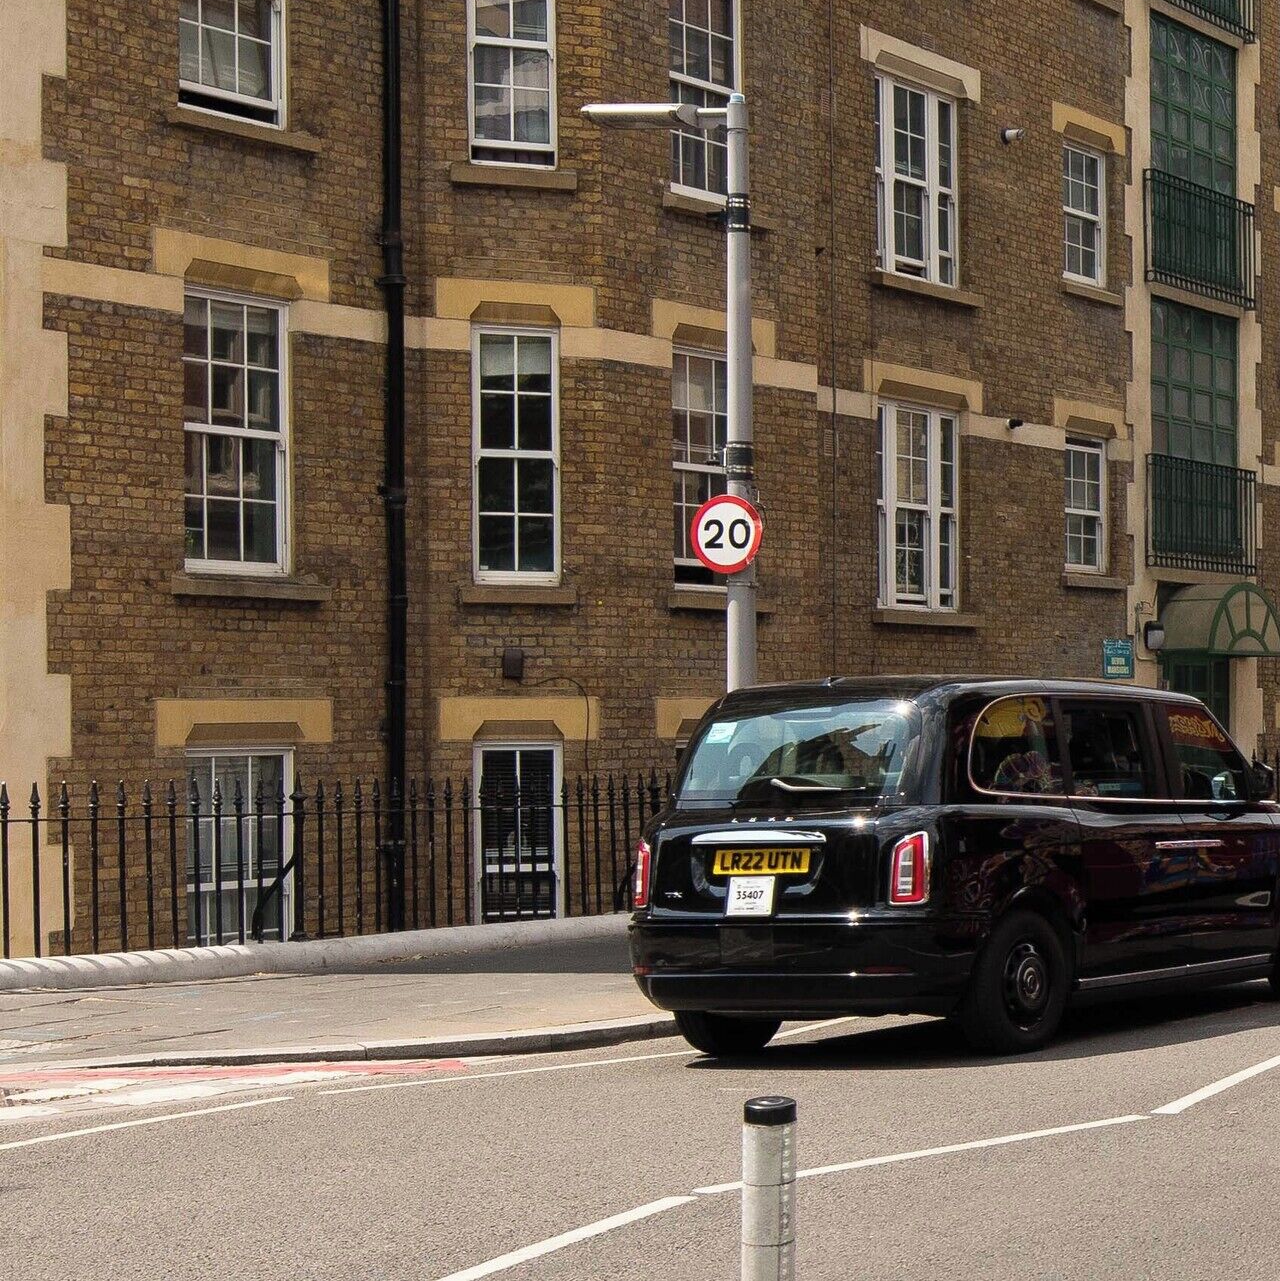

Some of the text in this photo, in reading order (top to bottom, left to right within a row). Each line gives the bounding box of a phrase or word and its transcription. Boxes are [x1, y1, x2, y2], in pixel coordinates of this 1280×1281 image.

[704, 518, 751, 549] 20
[720, 852, 802, 871] LR22 UTN
[736, 891, 764, 900] 35407
